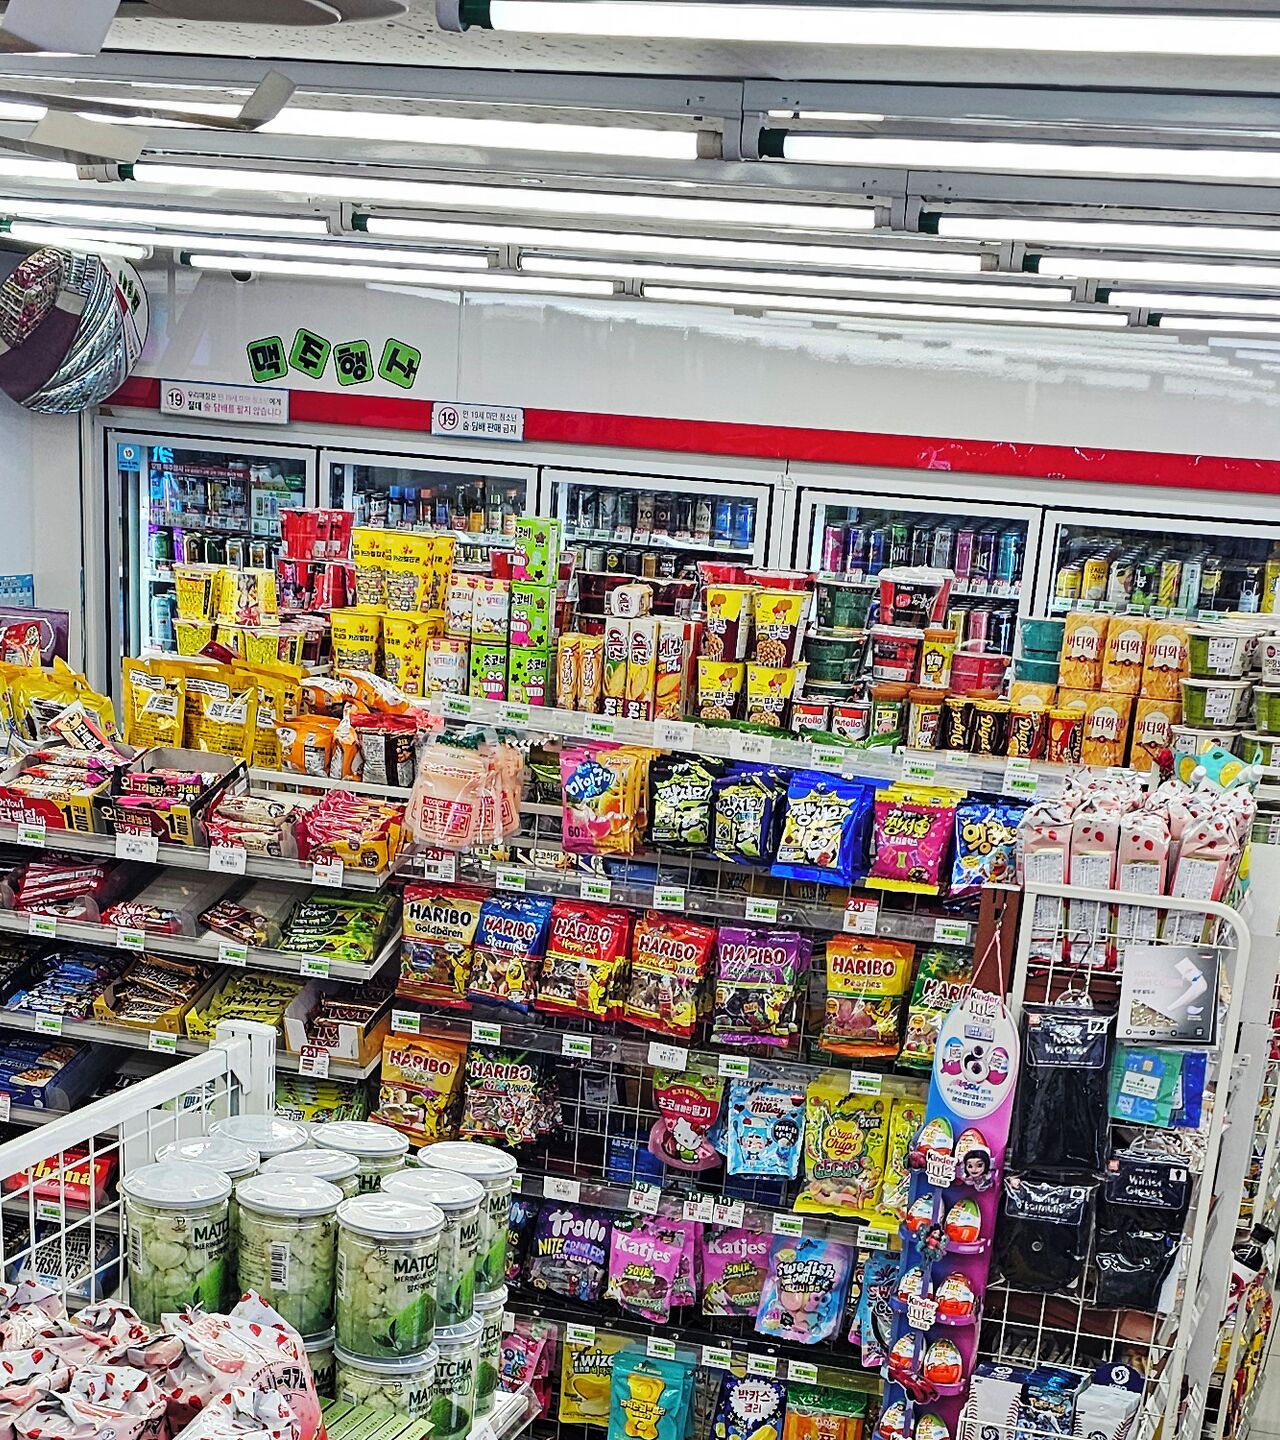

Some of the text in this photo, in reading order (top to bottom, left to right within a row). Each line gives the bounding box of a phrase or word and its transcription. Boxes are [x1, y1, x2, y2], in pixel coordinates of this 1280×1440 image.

[249, 333, 418, 381] 맥주행사
[441, 411, 456, 426] 19
[409, 903, 472, 927] HARIBO
[847, 900, 864, 912] 2+1
[414, 923, 463, 939] Goldbären
[484, 917, 537, 941] HARIBO
[555, 918, 611, 943] HARIBO
[638, 934, 697, 961] HARIBO
[721, 943, 787, 967] HARIBO
[831, 955, 897, 978] HARIBO
[923, 978, 970, 1000] HARI
[389, 1050, 452, 1077] HARIBO
[470, 1060, 532, 1082] HARIBO
[548, 1208, 607, 1242] Trolli
[538, 1238, 563, 1257] NITE
[616, 1237, 672, 1264] Katjes
[708, 1237, 767, 1258] Katjes
[431, 1359, 473, 1376] ATCHA
[738, 1389, 771, 1402] 박카스
